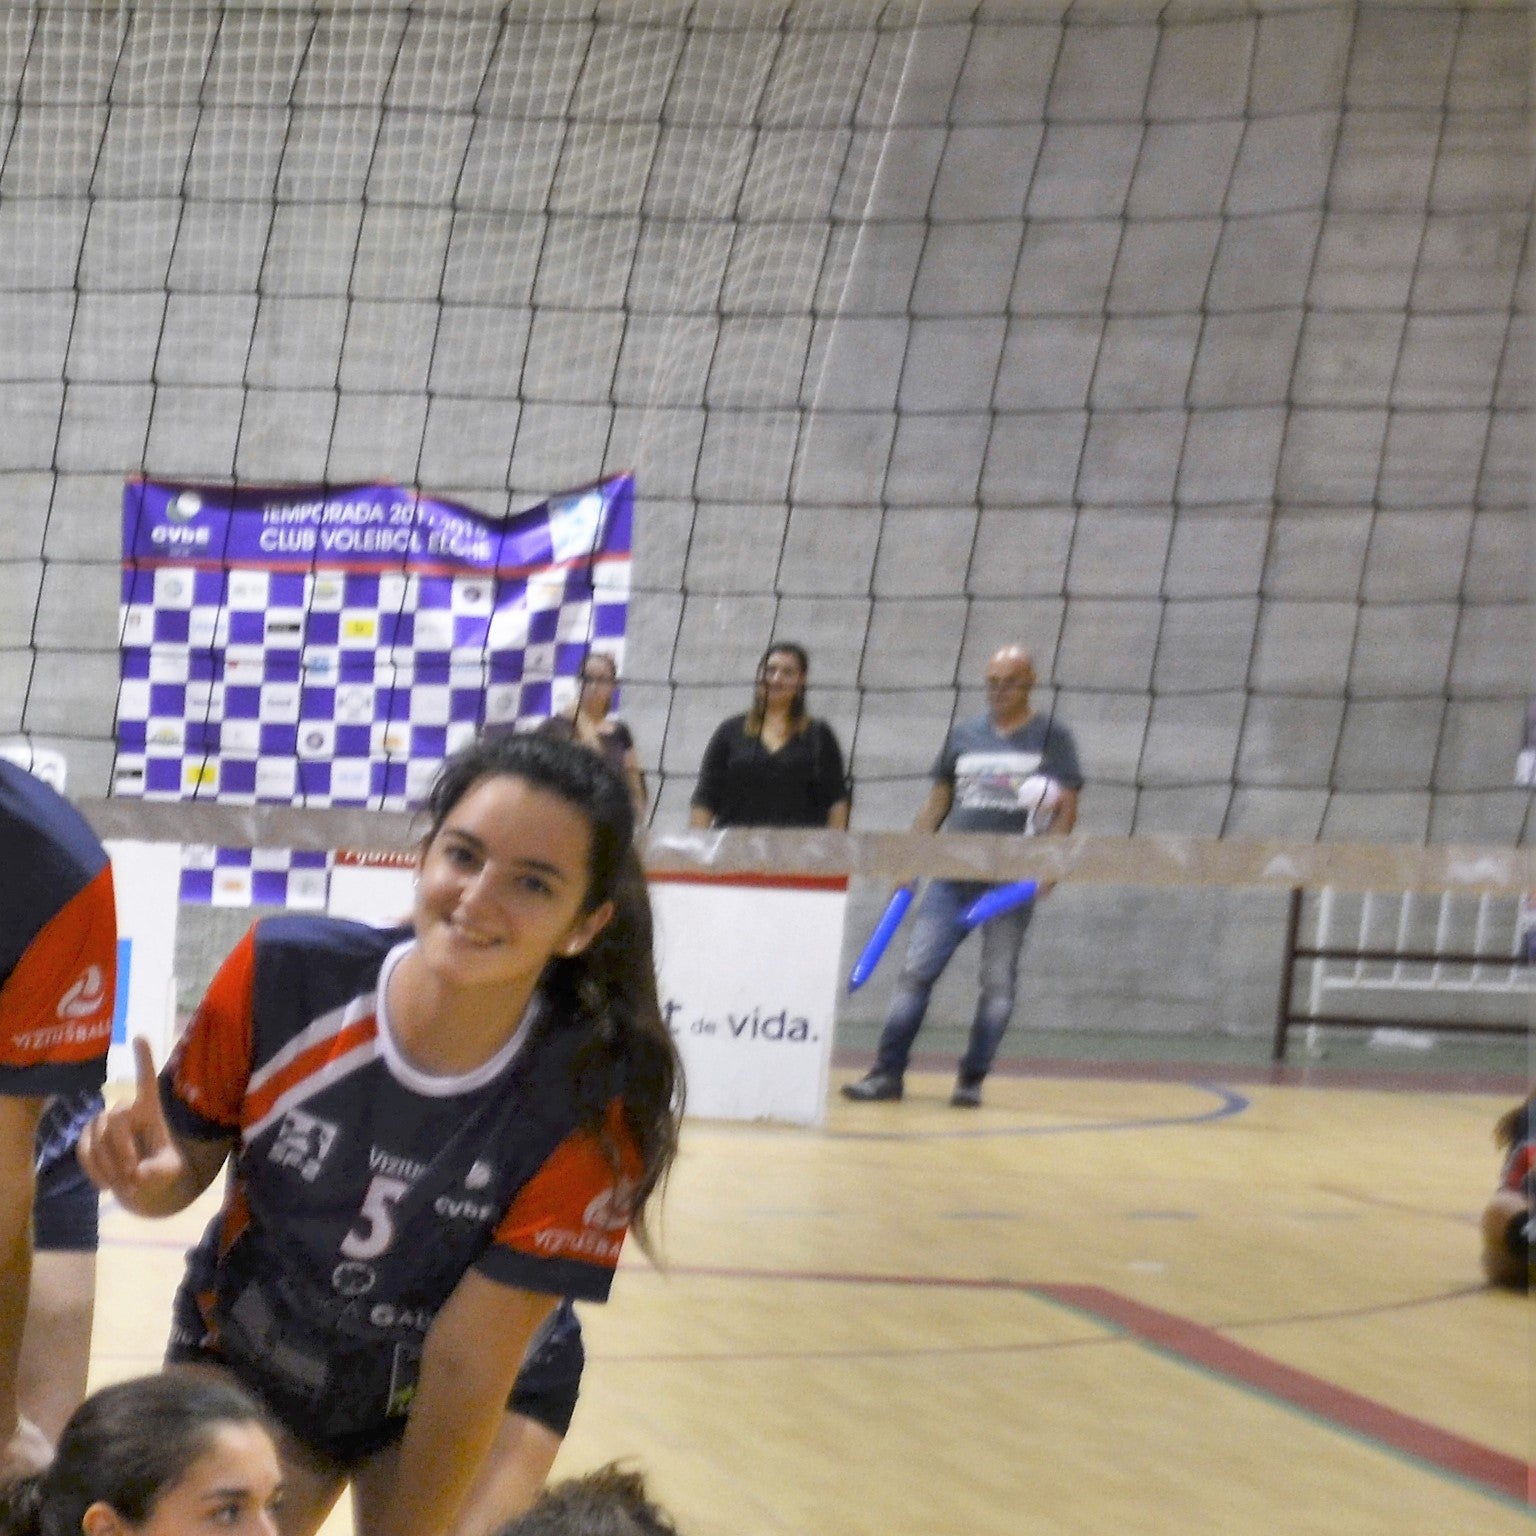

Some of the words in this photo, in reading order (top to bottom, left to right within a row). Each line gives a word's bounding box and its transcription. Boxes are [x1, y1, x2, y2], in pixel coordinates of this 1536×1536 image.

[262, 502, 384, 526] TEMPORADA
[260, 527, 317, 552] CLUB
[321, 529, 421, 553] VOLEIBOL
[690, 1018, 716, 1035] de
[728, 1007, 818, 1042] vida.
[339, 1175, 410, 1260] 5
